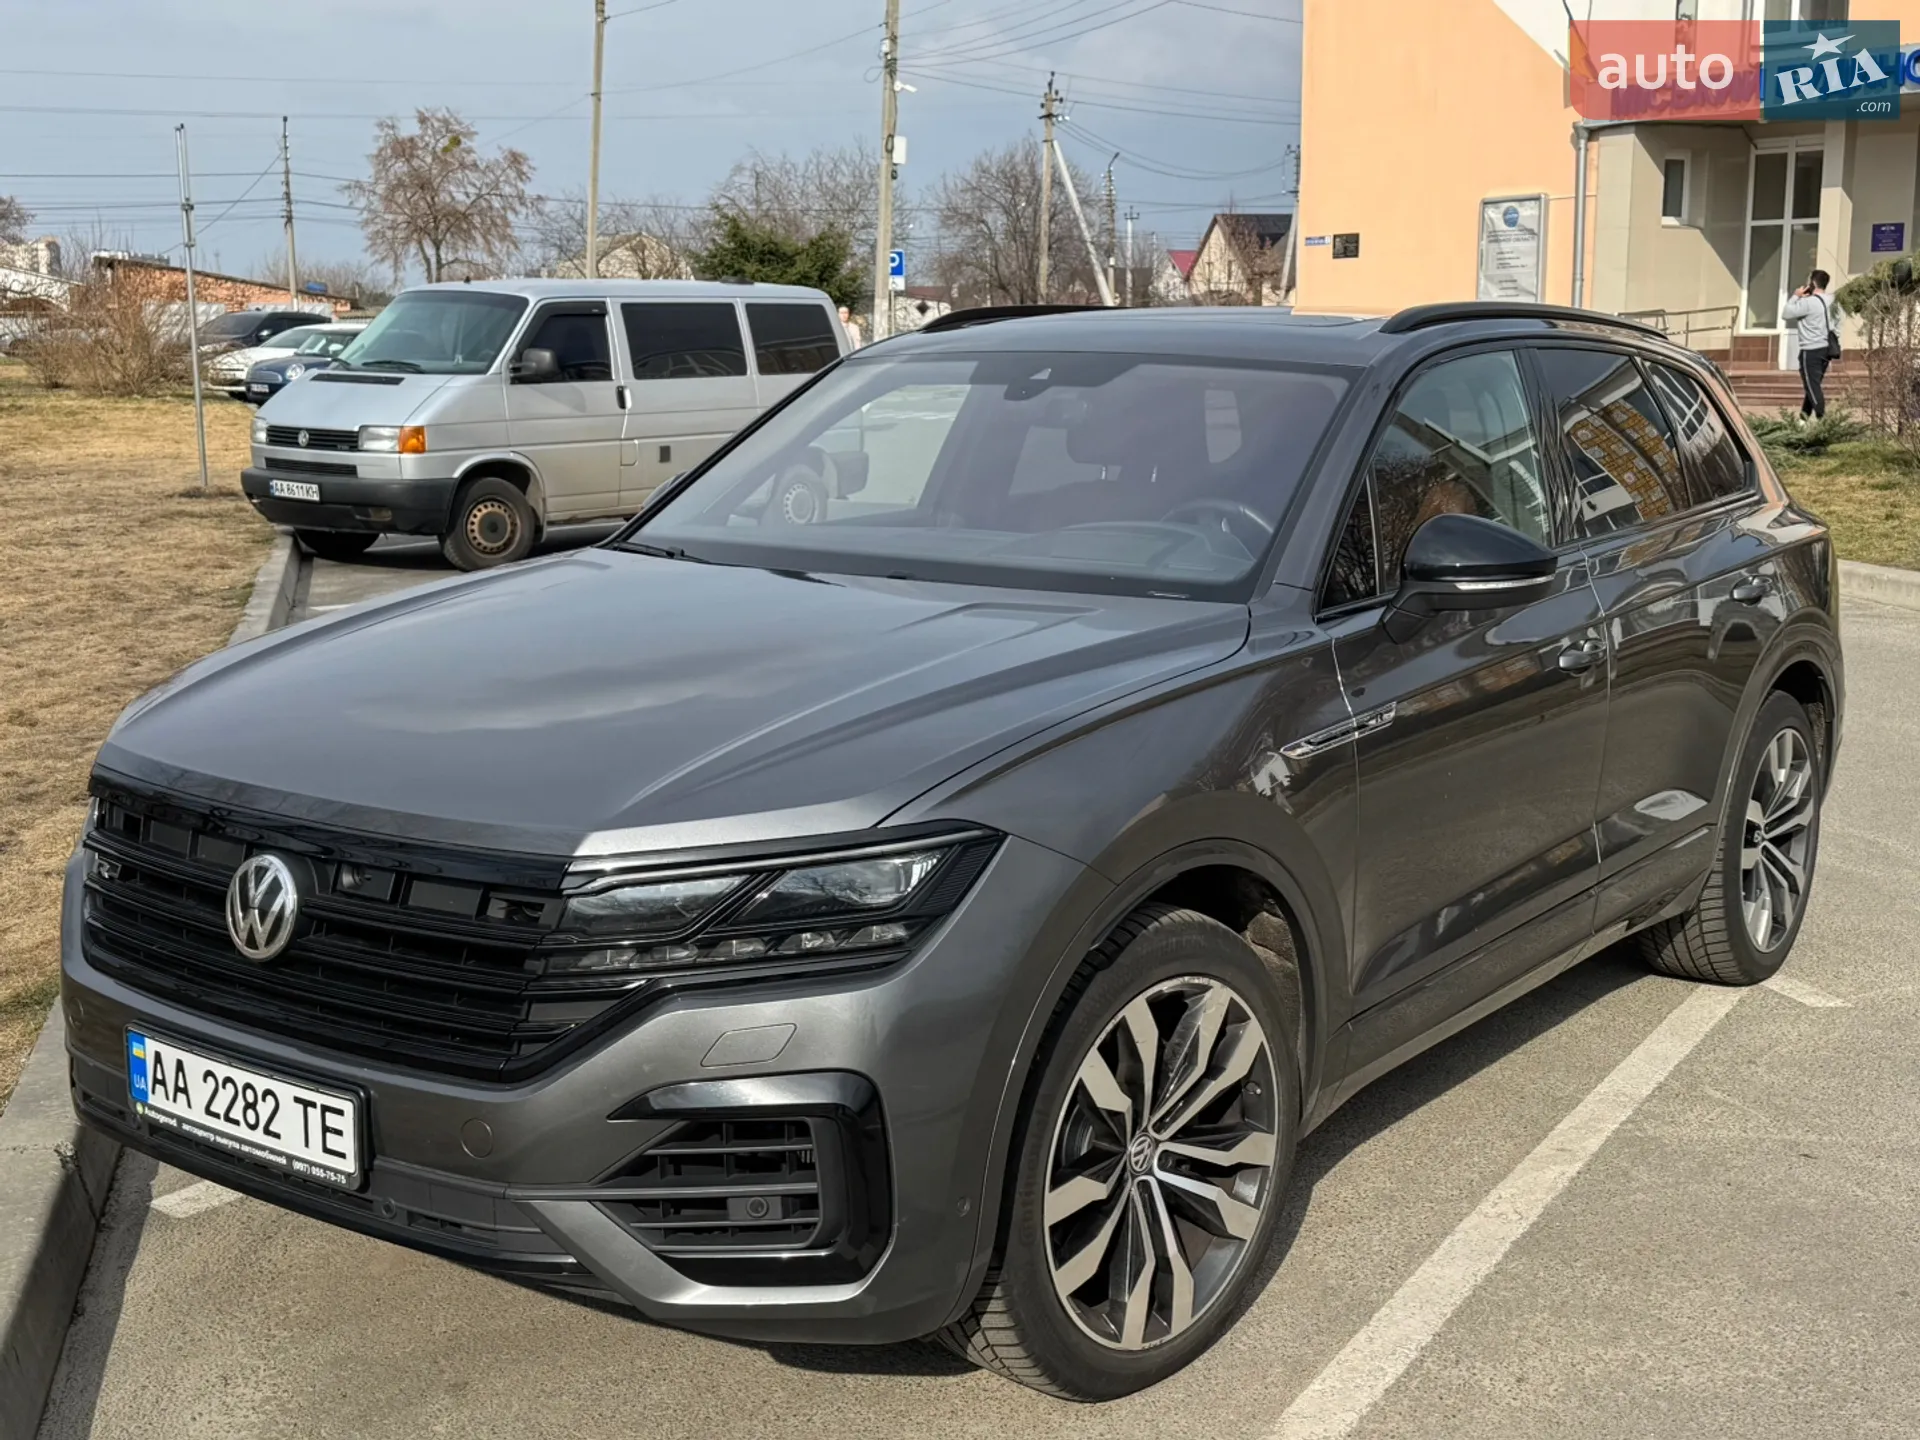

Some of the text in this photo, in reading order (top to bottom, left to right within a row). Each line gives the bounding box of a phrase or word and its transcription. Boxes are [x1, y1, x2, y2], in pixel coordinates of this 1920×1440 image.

[134, 1073, 147, 1092] UA
[152, 1050, 347, 1160] AA 2282 TE
